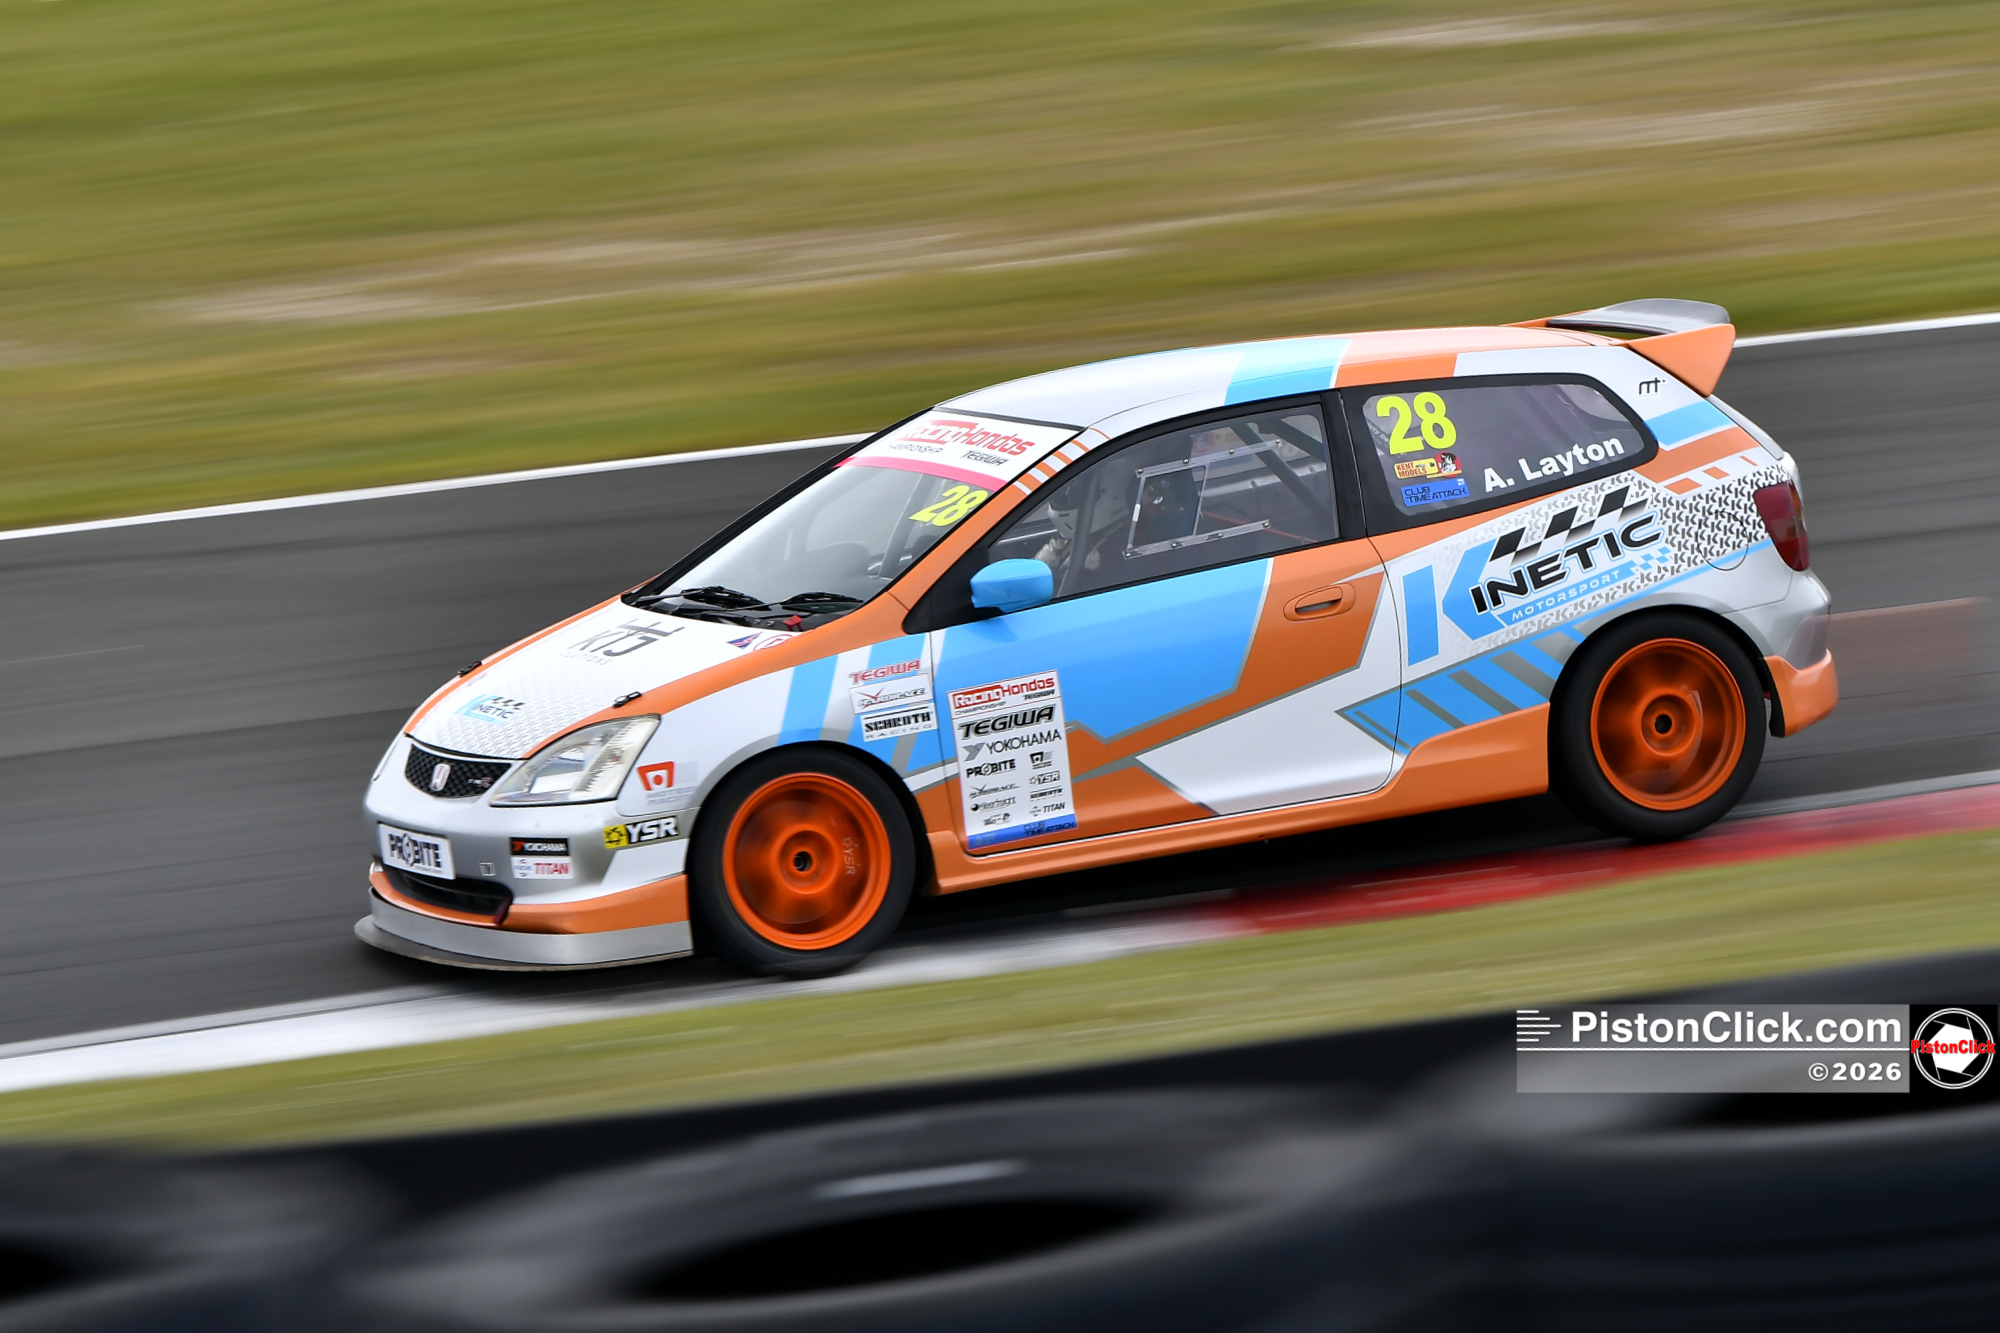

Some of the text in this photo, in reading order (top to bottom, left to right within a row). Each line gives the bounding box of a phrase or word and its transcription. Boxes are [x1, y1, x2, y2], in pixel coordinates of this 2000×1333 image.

[1376, 391, 1457, 455] 28
[960, 450, 1010, 467] TEGIWA
[1396, 461, 1415, 472] KENT
[1484, 437, 1625, 493] A. Layton
[1398, 467, 1428, 478] MODELS
[1404, 486, 1431, 497] CLUB
[909, 485, 989, 527] 28
[1511, 569, 1621, 622] MOTORSPORT
[849, 658, 922, 685] TEGIWA
[955, 689, 1056, 715] CHAMPIONSHIP TEGIWA
[864, 711, 931, 733] SCHROTH
[866, 724, 933, 740] RACING
[958, 704, 1056, 740] TEGIWA
[986, 729, 1062, 755] YOKOHAMA
[966, 758, 1017, 778] PROBITE
[1037, 771, 1061, 785] YSR
[1042, 802, 1066, 814] TITAN
[626, 817, 679, 843] YSR
[533, 862, 571, 875] TITAN
